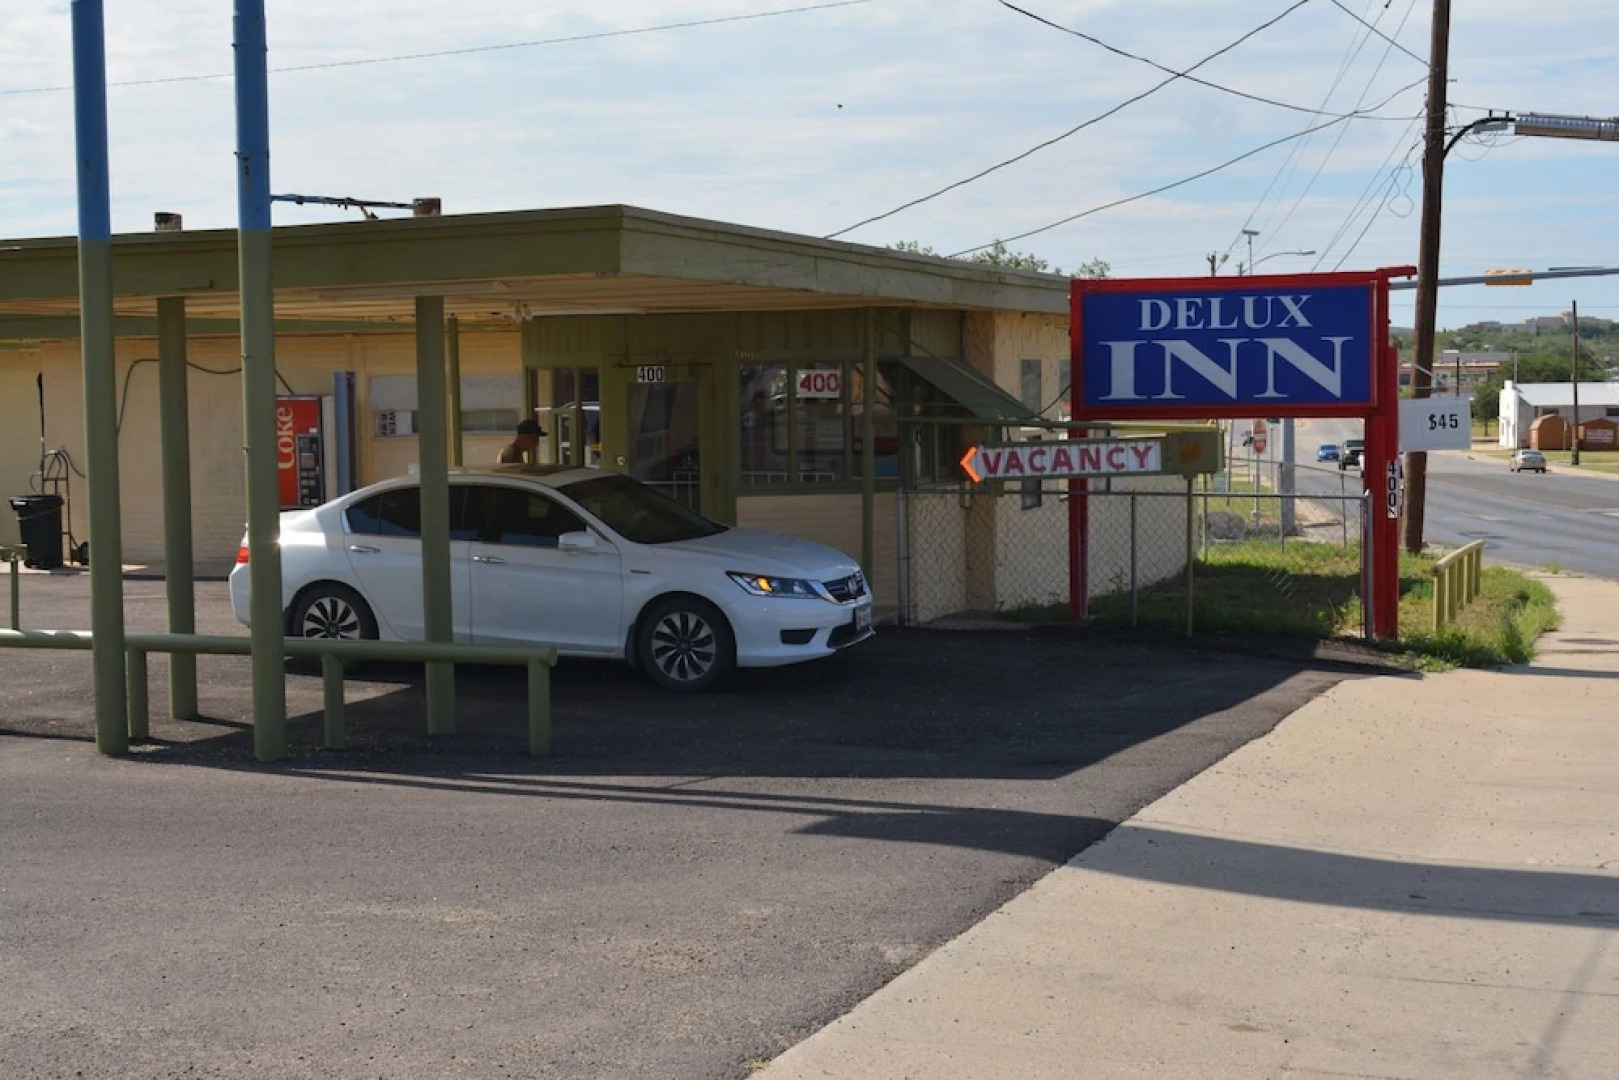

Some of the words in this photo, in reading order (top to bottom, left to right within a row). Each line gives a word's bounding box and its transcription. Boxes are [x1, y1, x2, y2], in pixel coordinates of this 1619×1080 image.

[1138, 296, 1312, 329] DELUX
[639, 367, 662, 381] 400
[1099, 336, 1354, 401] INN
[799, 373, 838, 392] 400
[1429, 413, 1458, 430] $45
[982, 445, 1152, 475] VACANCY
